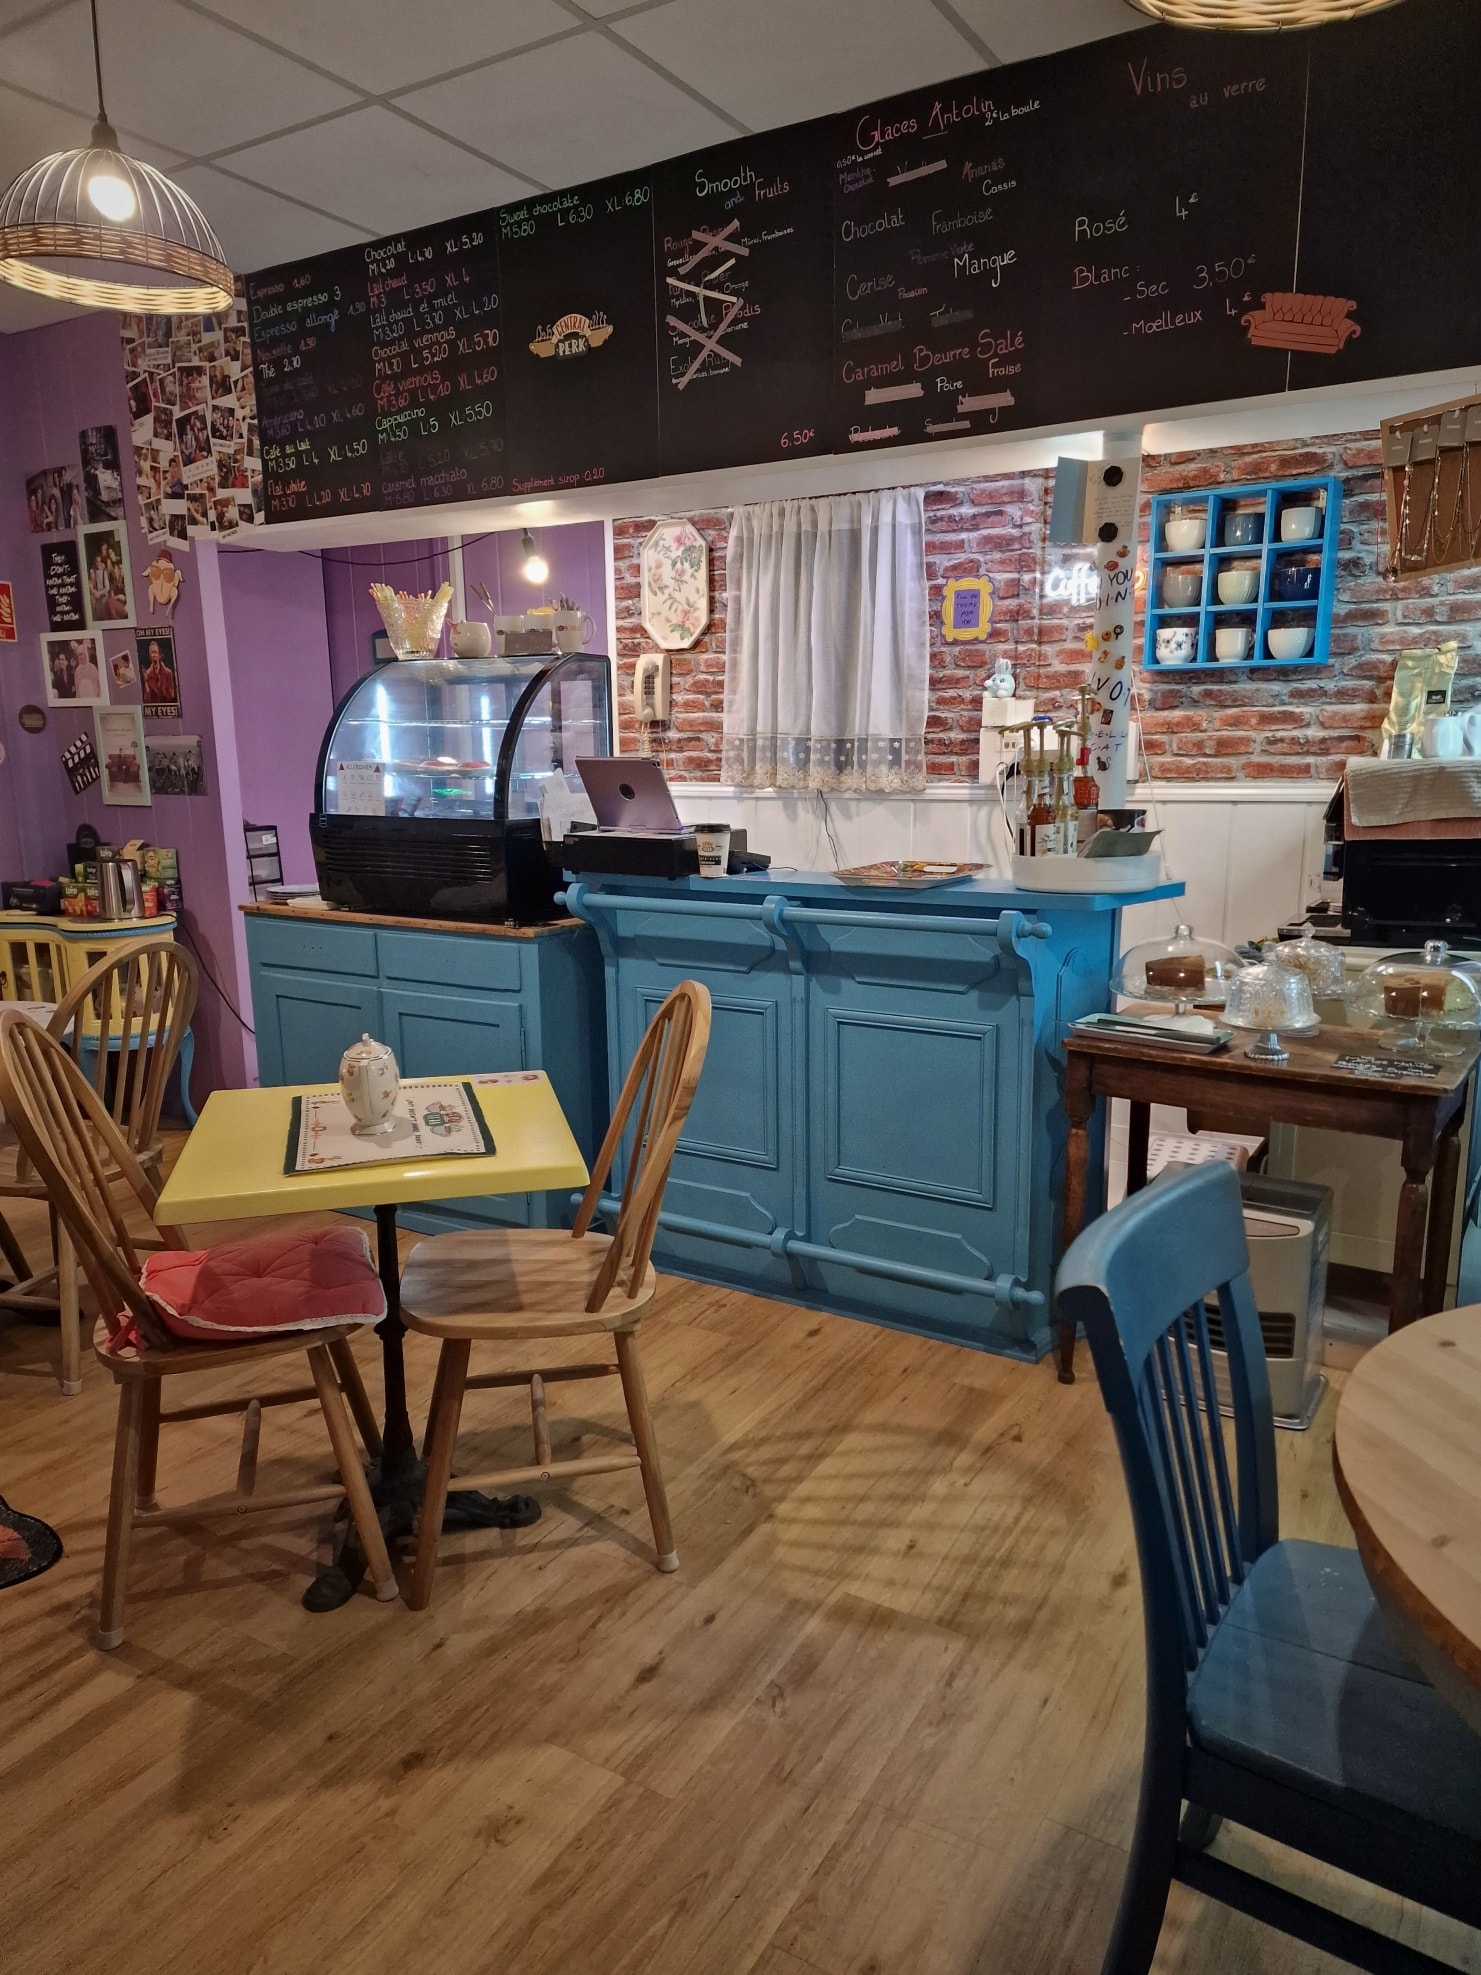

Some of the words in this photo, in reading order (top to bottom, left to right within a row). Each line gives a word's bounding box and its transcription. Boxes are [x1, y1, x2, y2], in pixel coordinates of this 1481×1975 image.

[1127, 55, 1187, 96] Vins
[1222, 76, 1267, 98] verre
[1011, 99, 1041, 117] boule
[856, 115, 918, 151] Glaces
[928, 96, 995, 131] Antolin
[695, 165, 756, 197] Smooth
[724, 190, 745, 210] and
[755, 177, 790, 202] Fruits
[982, 179, 1018, 197] Cassis
[499, 205, 530, 226] Sweet
[532, 193, 581, 217] chocolate
[841, 208, 907, 242] Chocolat
[930, 208, 994, 236] Framboise
[1075, 208, 1128, 243] Rosé
[364, 238, 407, 263] Chocolat
[953, 249, 1018, 289] Mangue
[846, 273, 896, 301] Cerise
[556, 314, 589, 338] CENTRAL
[558, 337, 587, 357] PERK
[842, 353, 905, 383] Caramel
[913, 345, 971, 371] Beurre
[976, 328, 1025, 359] Salé
[988, 357, 1022, 379] Fraise
[936, 376, 964, 393] Poire
[144, 706, 157, 717] MY
[157, 705, 179, 717] EYES!
